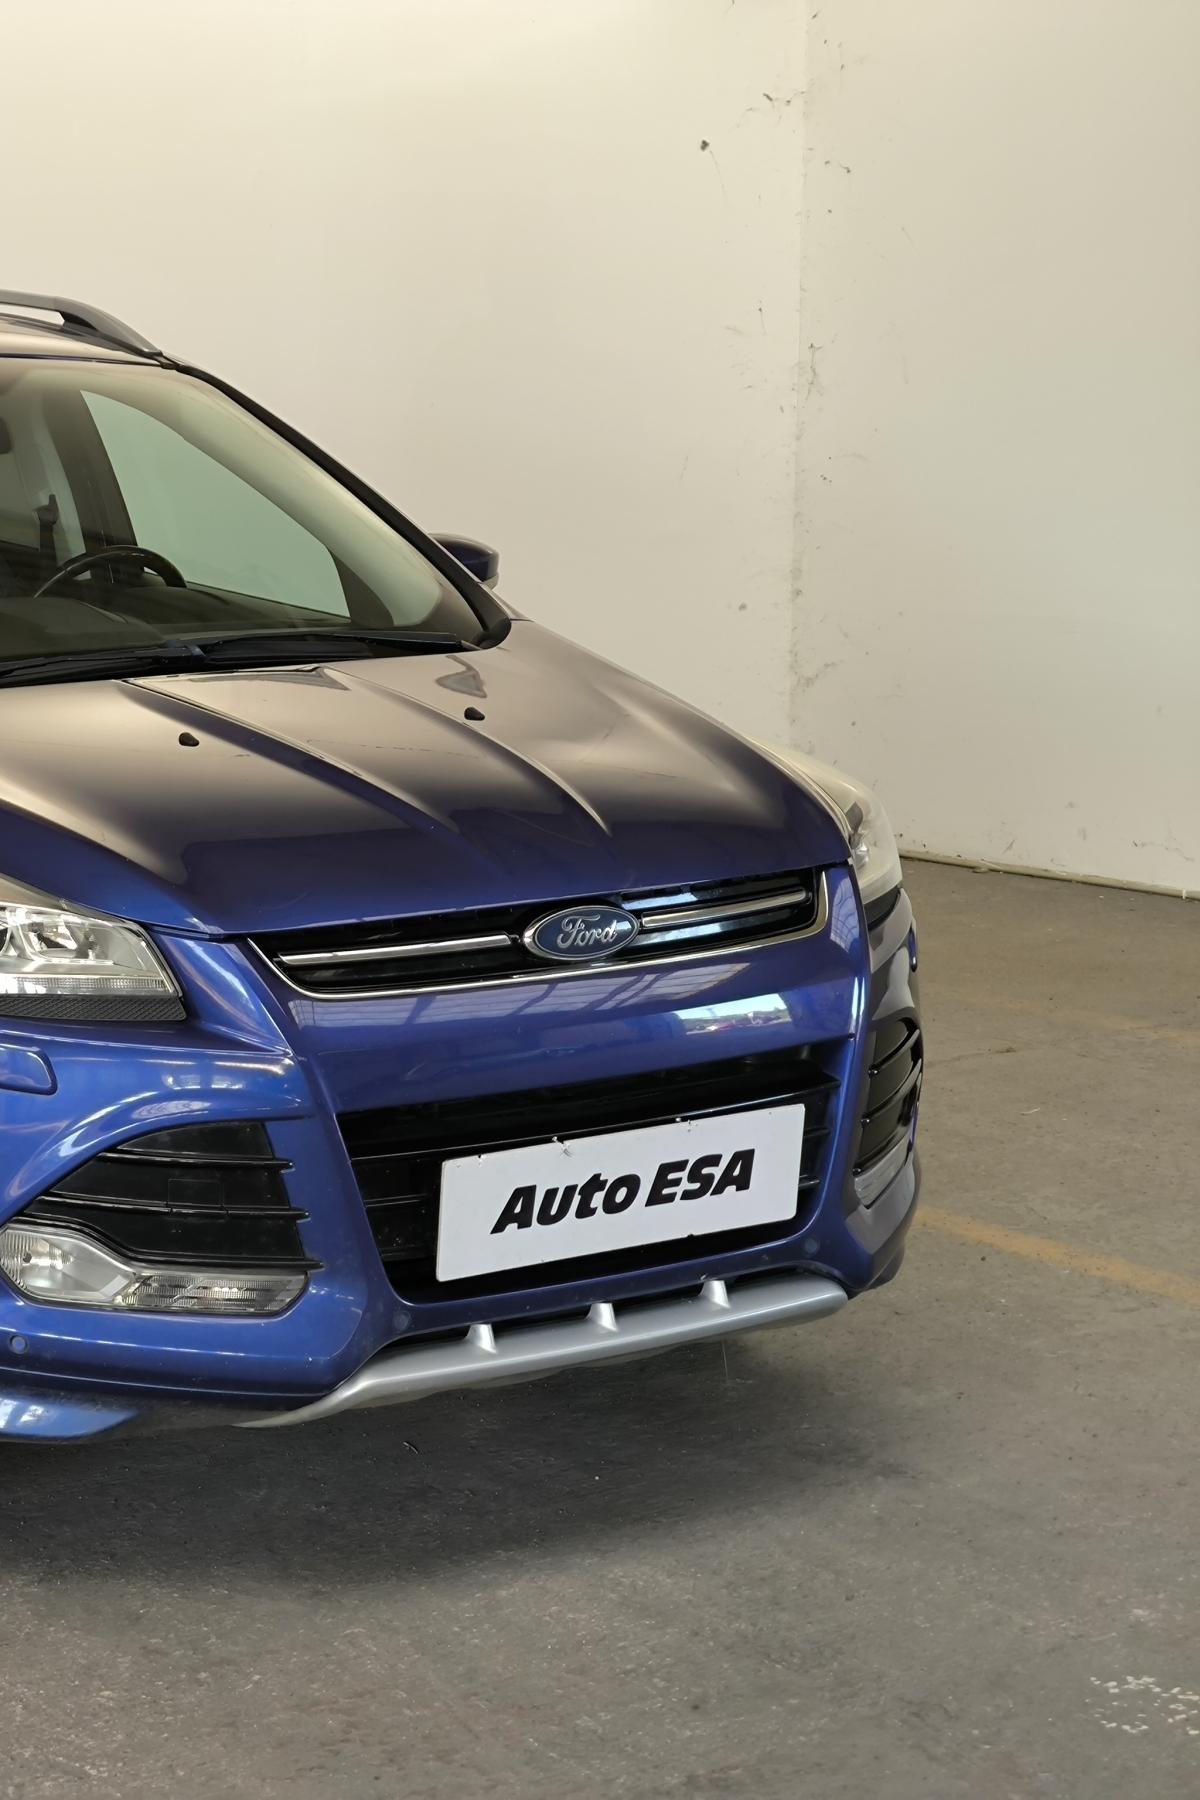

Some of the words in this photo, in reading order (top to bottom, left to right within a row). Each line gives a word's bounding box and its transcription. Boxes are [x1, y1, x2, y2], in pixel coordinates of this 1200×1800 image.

[557, 914, 618, 949] Ford
[490, 1173, 641, 1235] Auto
[645, 1148, 756, 1207] ESA
